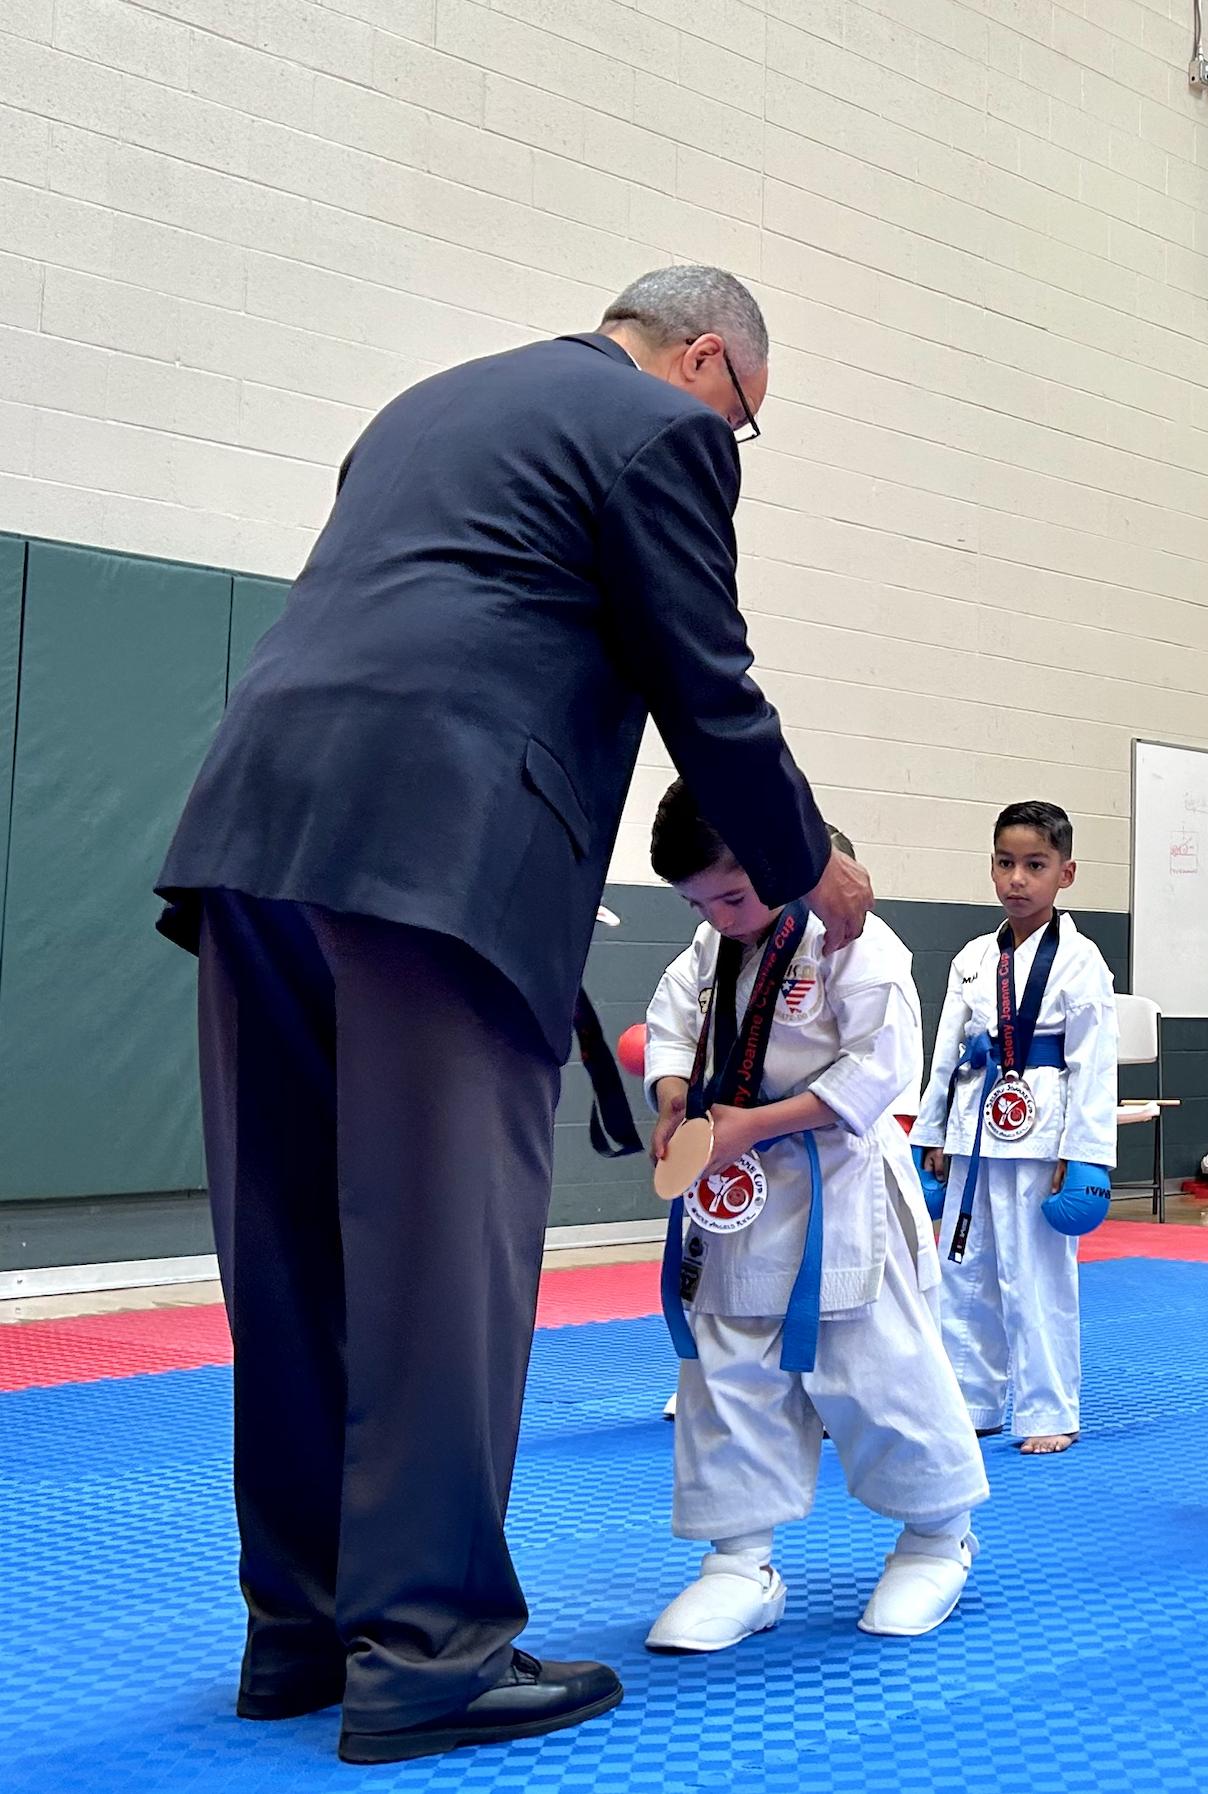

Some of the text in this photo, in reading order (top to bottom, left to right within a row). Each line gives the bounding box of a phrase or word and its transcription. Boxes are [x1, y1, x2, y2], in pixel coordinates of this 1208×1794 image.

[773, 914, 796, 950] Cup
[999, 952, 1014, 1068] Seleny Joanne Cup
